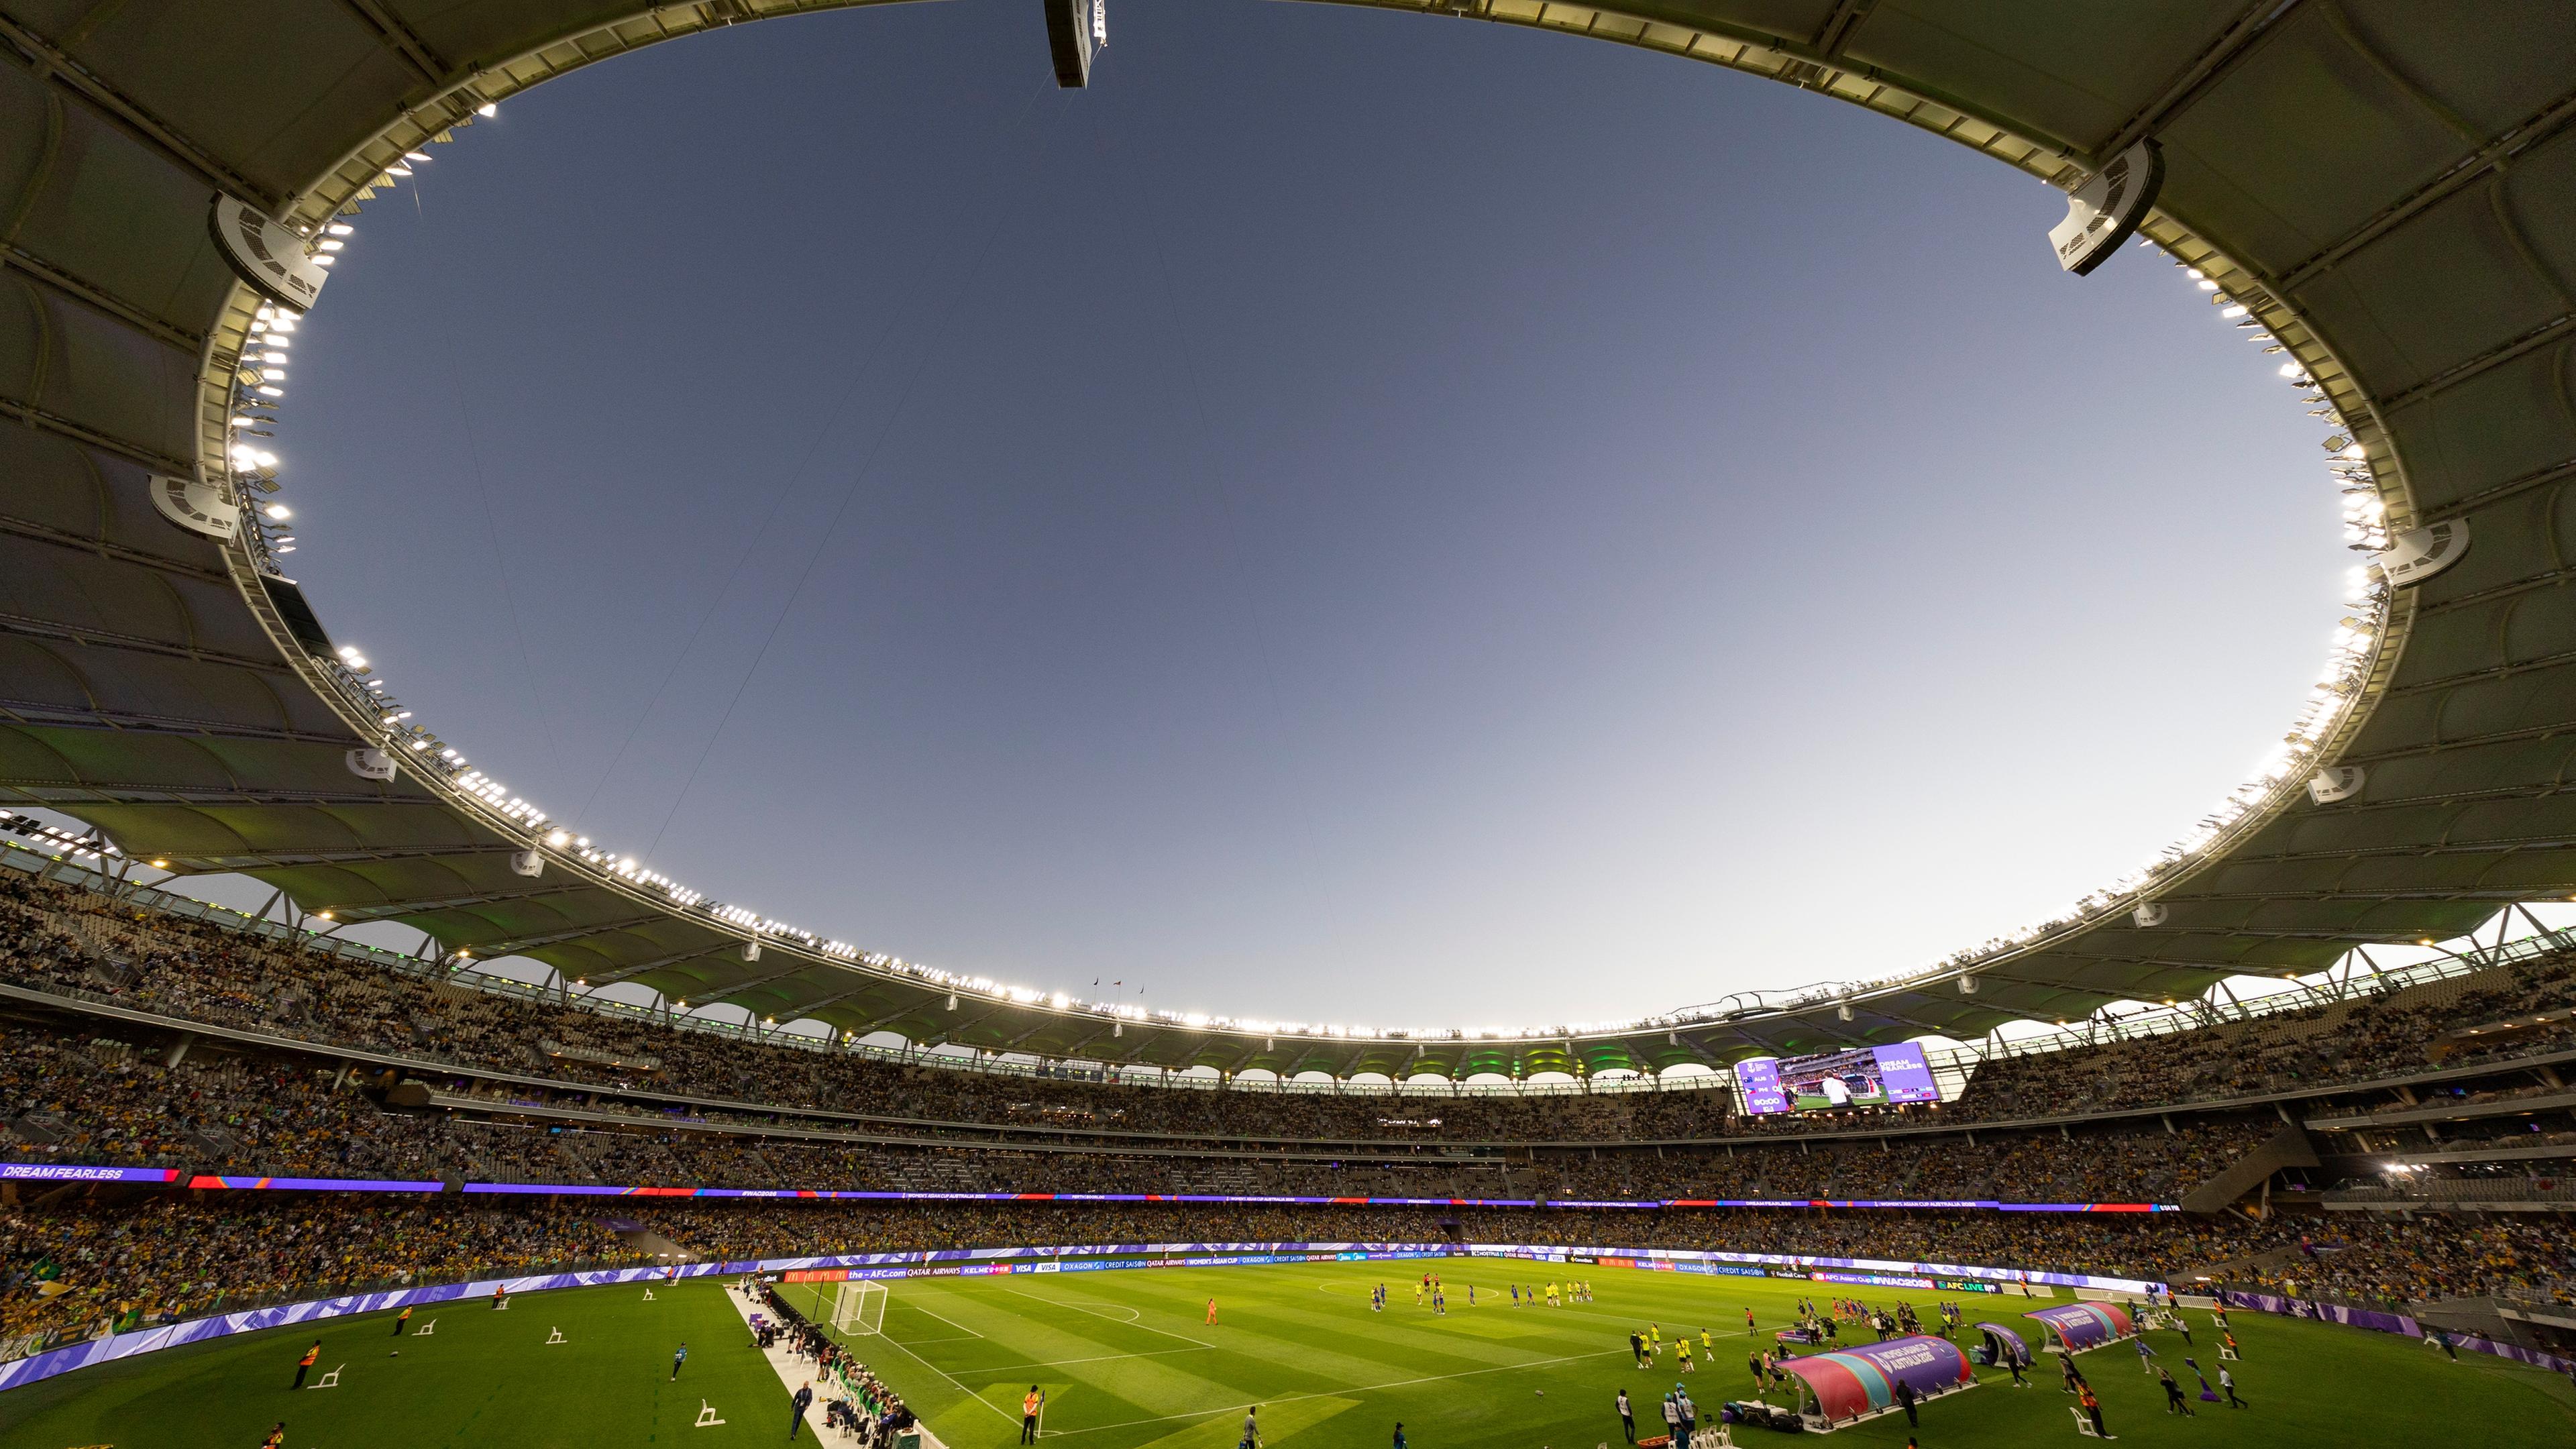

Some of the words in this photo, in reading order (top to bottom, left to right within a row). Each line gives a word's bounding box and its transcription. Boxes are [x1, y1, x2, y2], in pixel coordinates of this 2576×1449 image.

[1879, 1059, 1909, 1068] DREAM
[1880, 1063, 1923, 1072] FEARLESS
[3, 1166, 56, 1177] DREAM
[54, 1168, 123, 1179] FEARLESS
[1016, 1265, 1032, 1273] VISA
[1105, 1260, 1124, 1269] CREDIT
[1679, 1264, 1706, 1272] OXAGON
[849, 1271, 863, 1279] the
[870, 1269, 906, 1278] AFC.com
[907, 1268, 930, 1277] QATAR
[932, 1267, 961, 1275] AIRWAYS
[1740, 1268, 1764, 1276] SAISON
[1872, 1276, 1933, 1289] #WAC2026
[1947, 1282, 1964, 1290] AFC
[1964, 1283, 1985, 1291] LIVE
